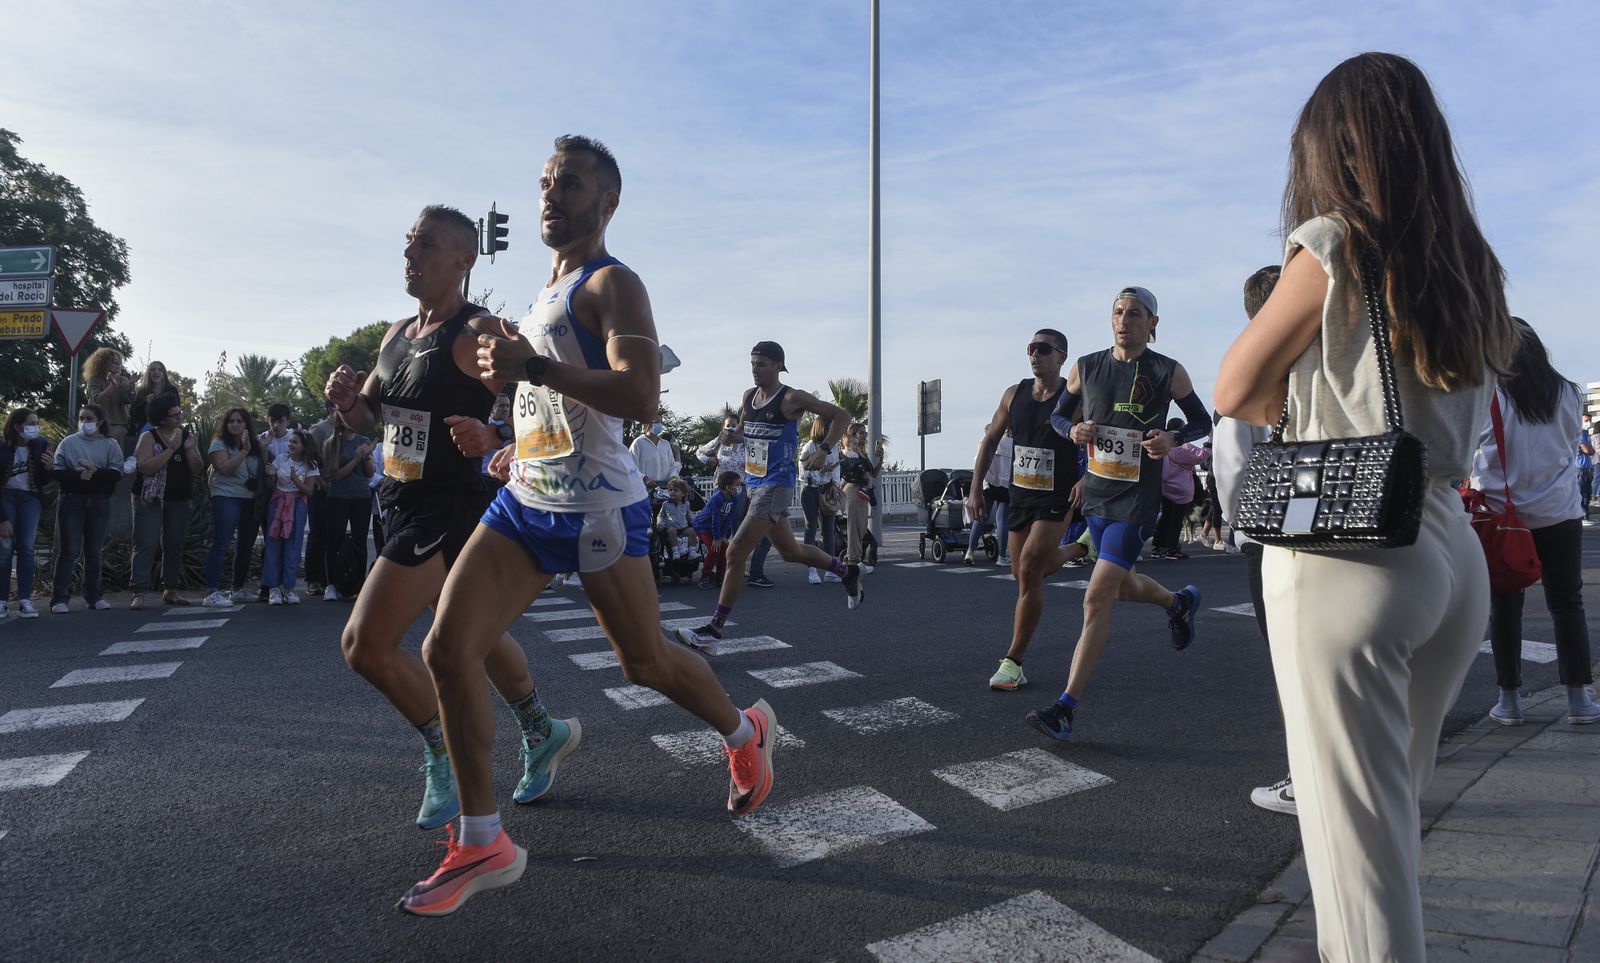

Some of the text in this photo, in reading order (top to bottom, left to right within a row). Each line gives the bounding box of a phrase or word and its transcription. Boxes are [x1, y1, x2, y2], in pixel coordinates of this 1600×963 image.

[13, 281, 45, 291] hospital
[13, 313, 42, 323] Prado
[519, 391, 536, 418] 96
[1096, 437, 1124, 455] 693
[1019, 456, 1041, 469] 377
